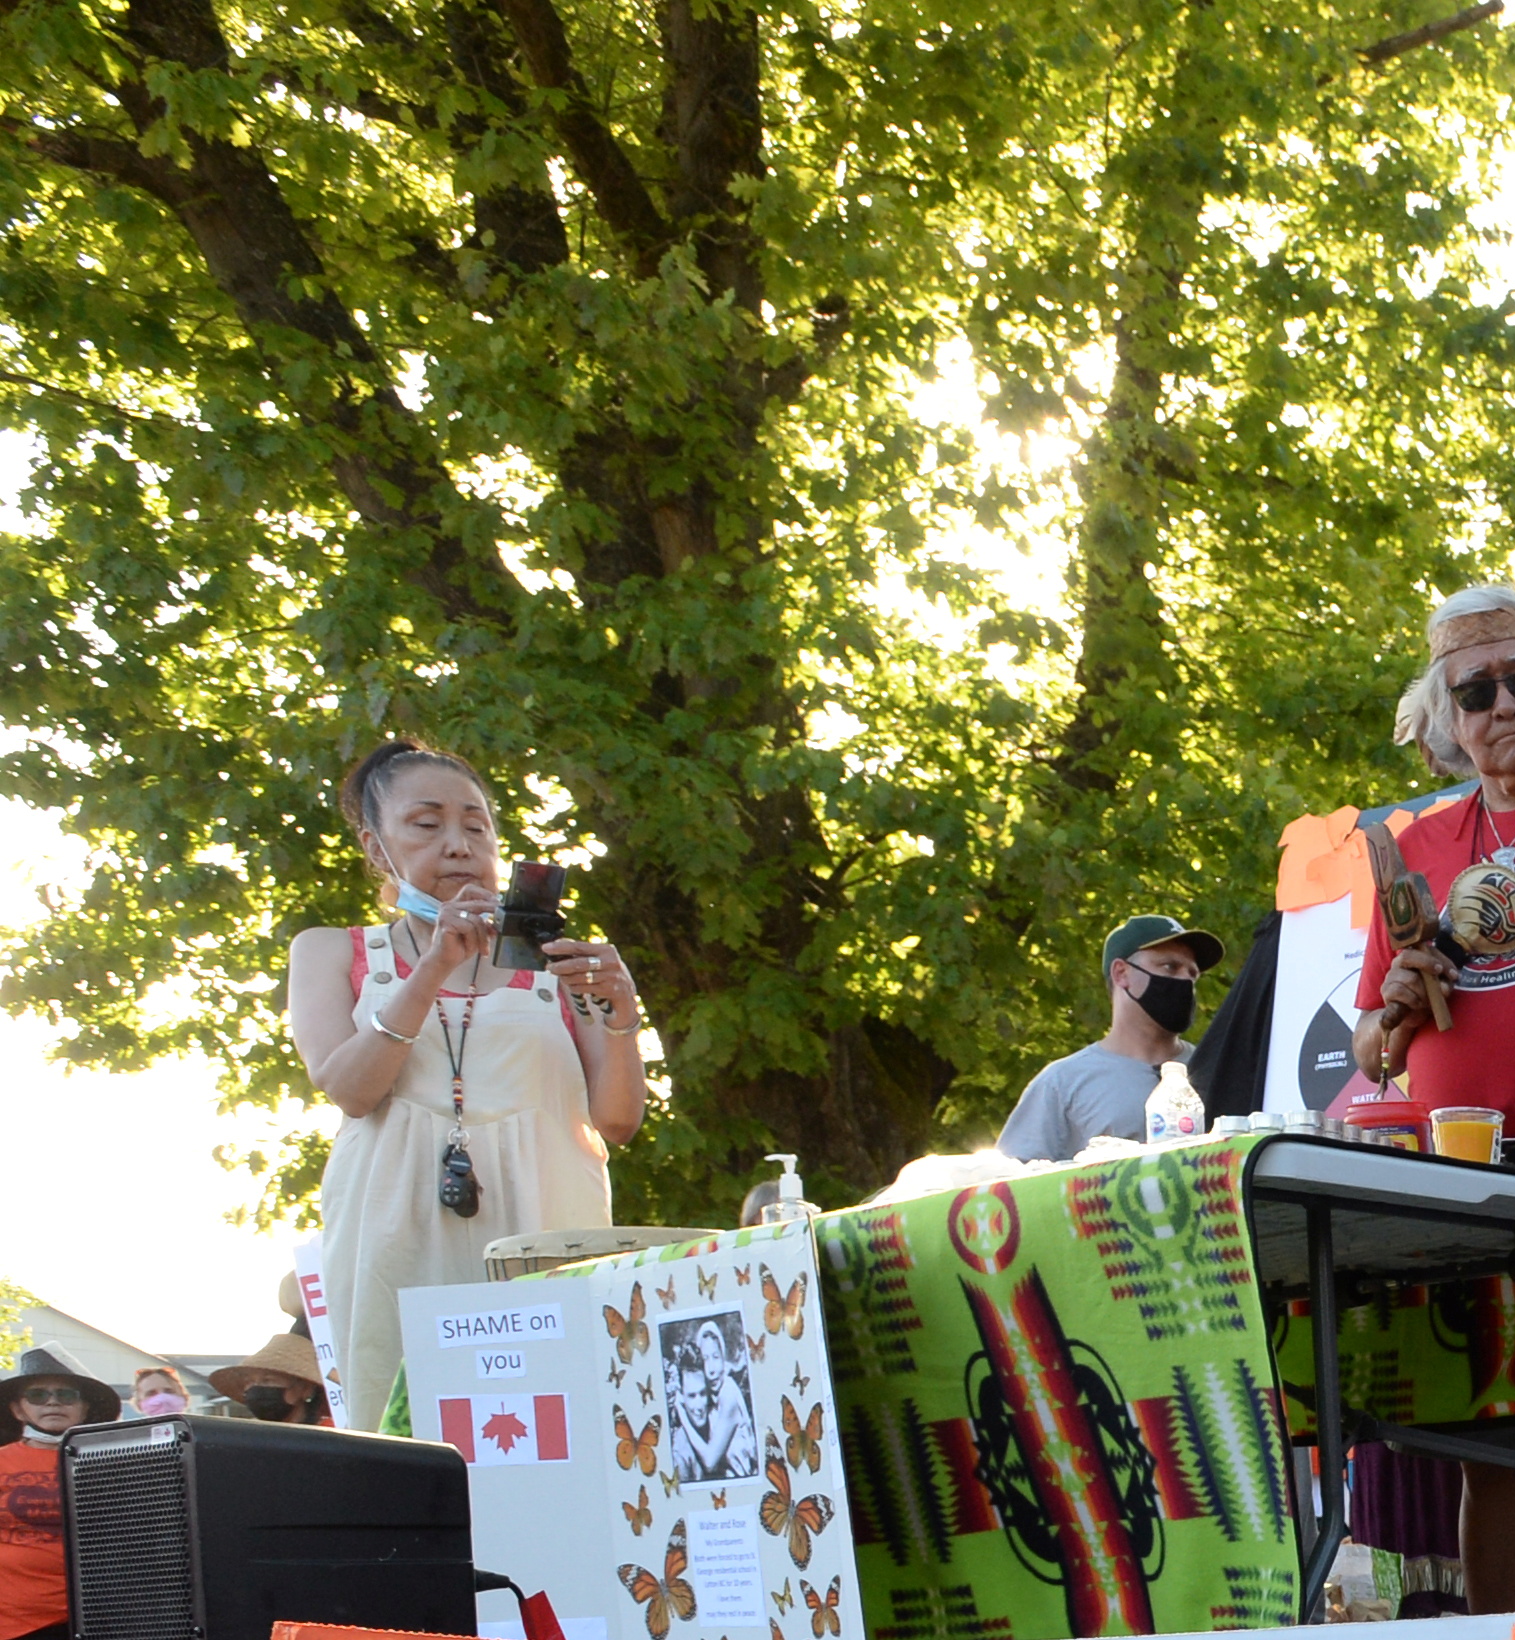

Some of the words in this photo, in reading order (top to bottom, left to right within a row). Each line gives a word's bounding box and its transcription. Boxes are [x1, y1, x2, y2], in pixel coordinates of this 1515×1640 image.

[1317, 1050, 1347, 1062] EARTH
[442, 1312, 523, 1340] SHAME
[529, 1313, 557, 1331] on
[481, 1353, 522, 1375] you
